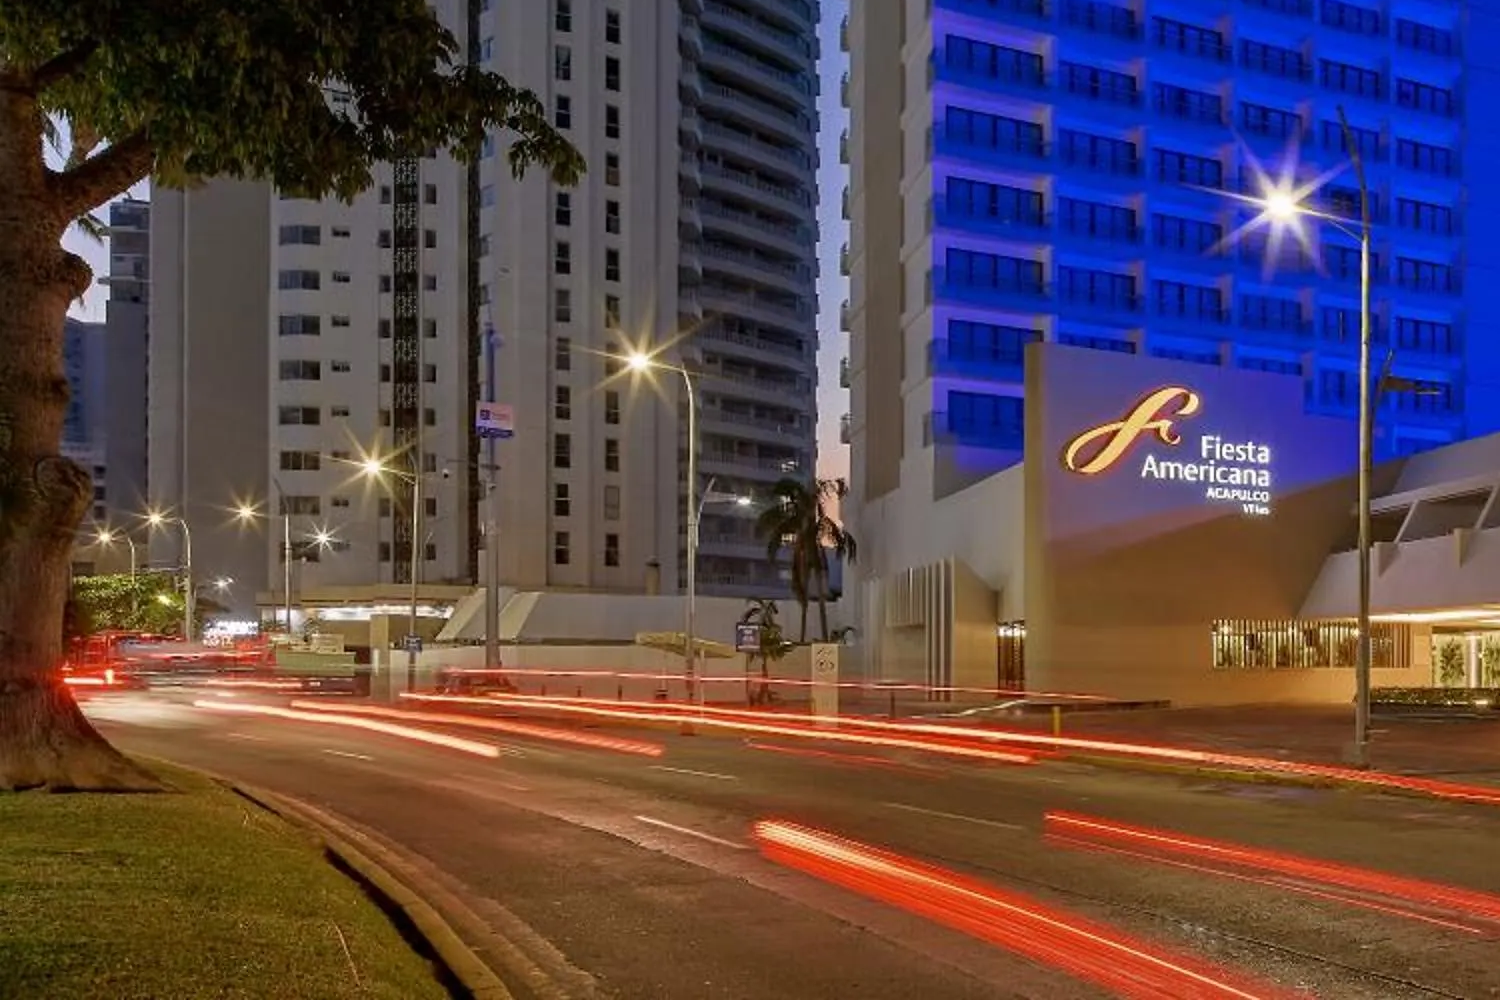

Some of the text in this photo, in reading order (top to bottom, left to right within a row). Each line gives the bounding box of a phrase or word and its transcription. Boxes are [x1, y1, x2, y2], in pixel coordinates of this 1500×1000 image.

[1200, 435, 1270, 463] Fiesta
[1141, 454, 1270, 486] Americana
[1206, 487, 1269, 503] ACAPULCO
